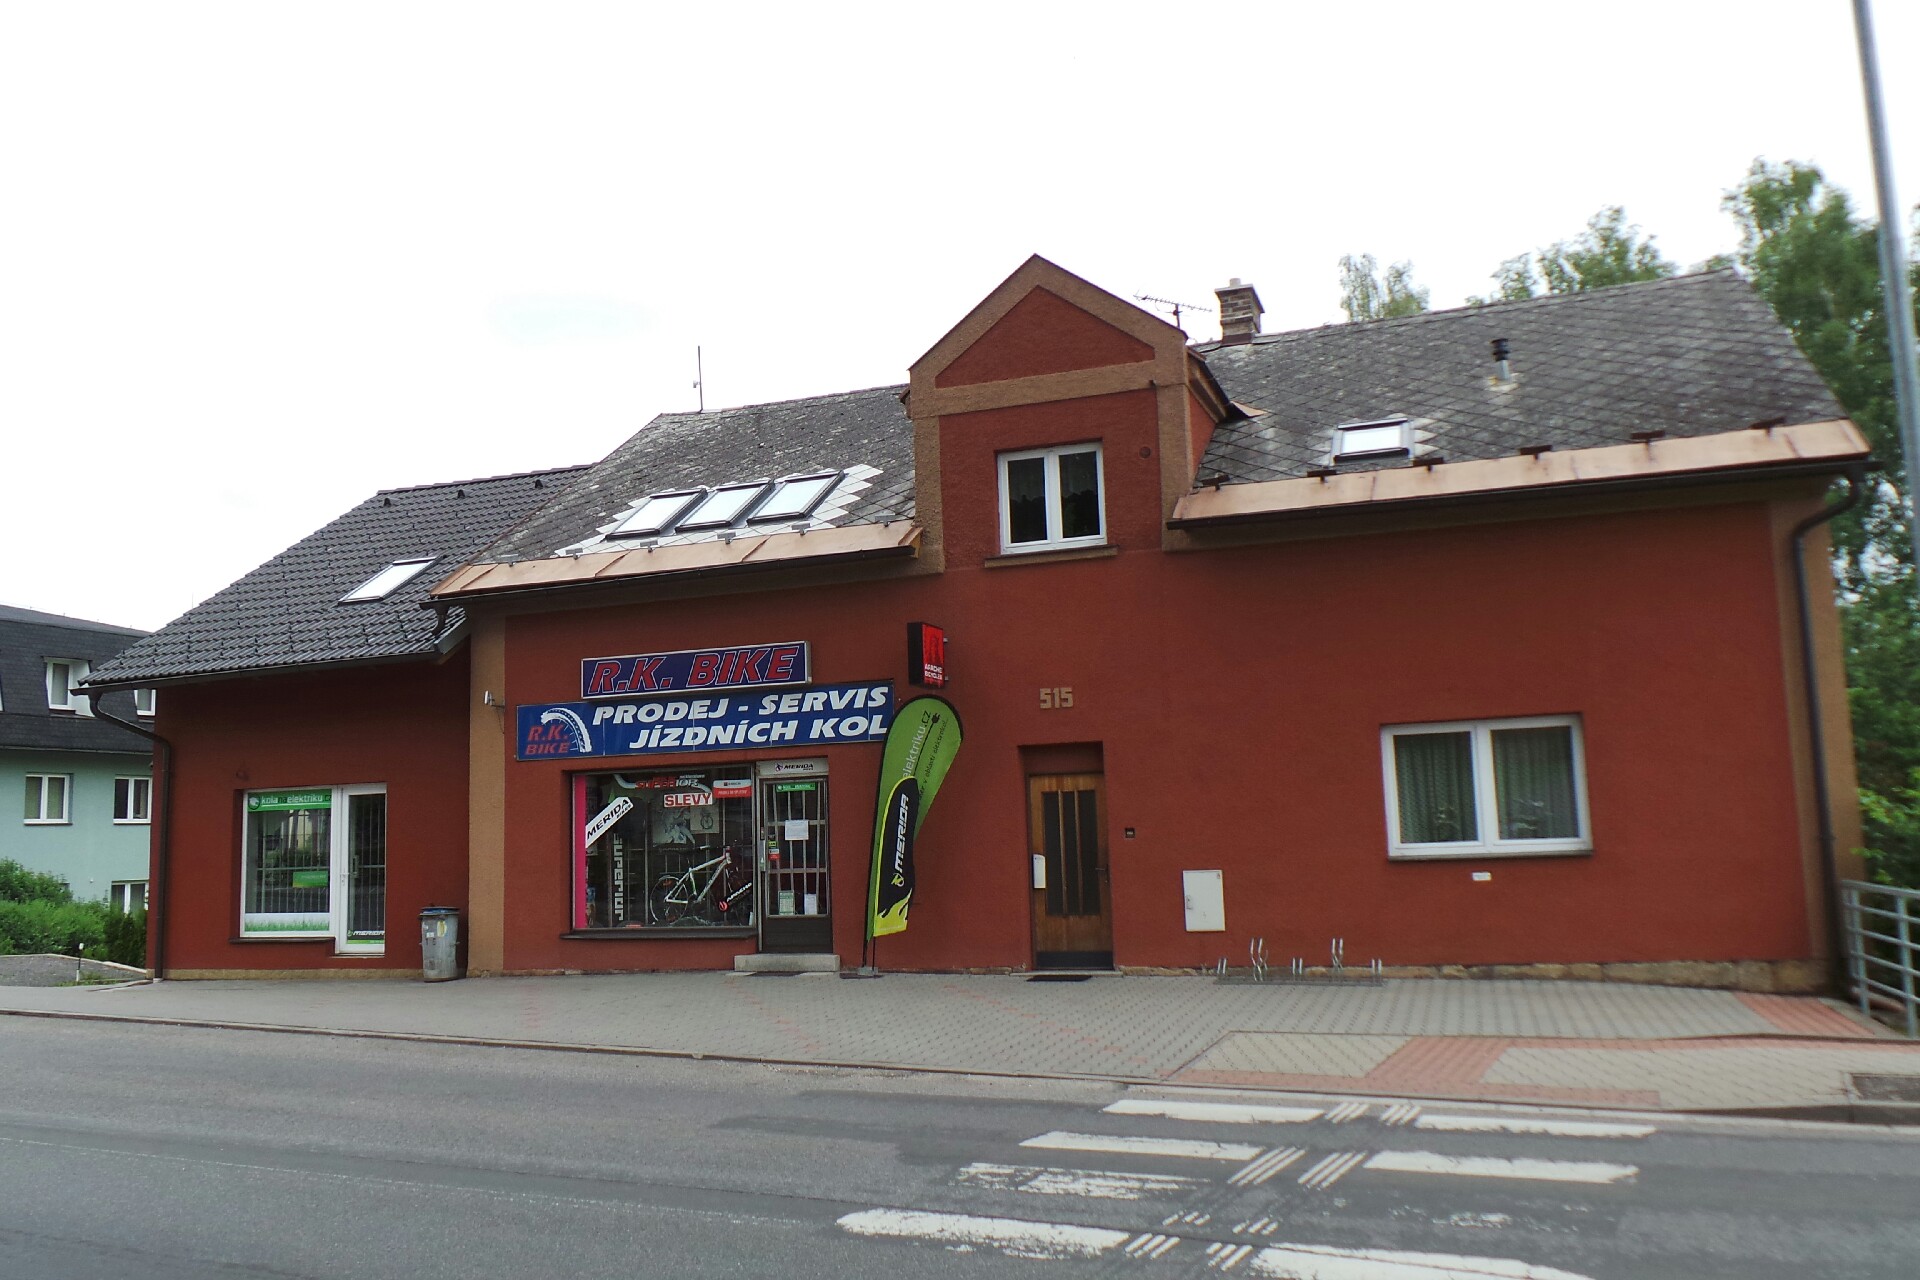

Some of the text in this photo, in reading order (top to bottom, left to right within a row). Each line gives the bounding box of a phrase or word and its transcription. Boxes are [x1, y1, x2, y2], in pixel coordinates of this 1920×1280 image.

[588, 646, 801, 695] R.K. BIKE
[592, 698, 729, 725] PRODEJ
[758, 686, 889, 715] SERVIS
[1040, 687, 1073, 708] 515
[525, 742, 570, 755] BIKE
[528, 724, 568, 741] R.K.
[629, 715, 888, 749] JÍZDNÍCH KOL
[664, 792, 712, 807] SLEVY
[587, 799, 630, 840] MERIDA
[895, 793, 909, 873] MERIDA
